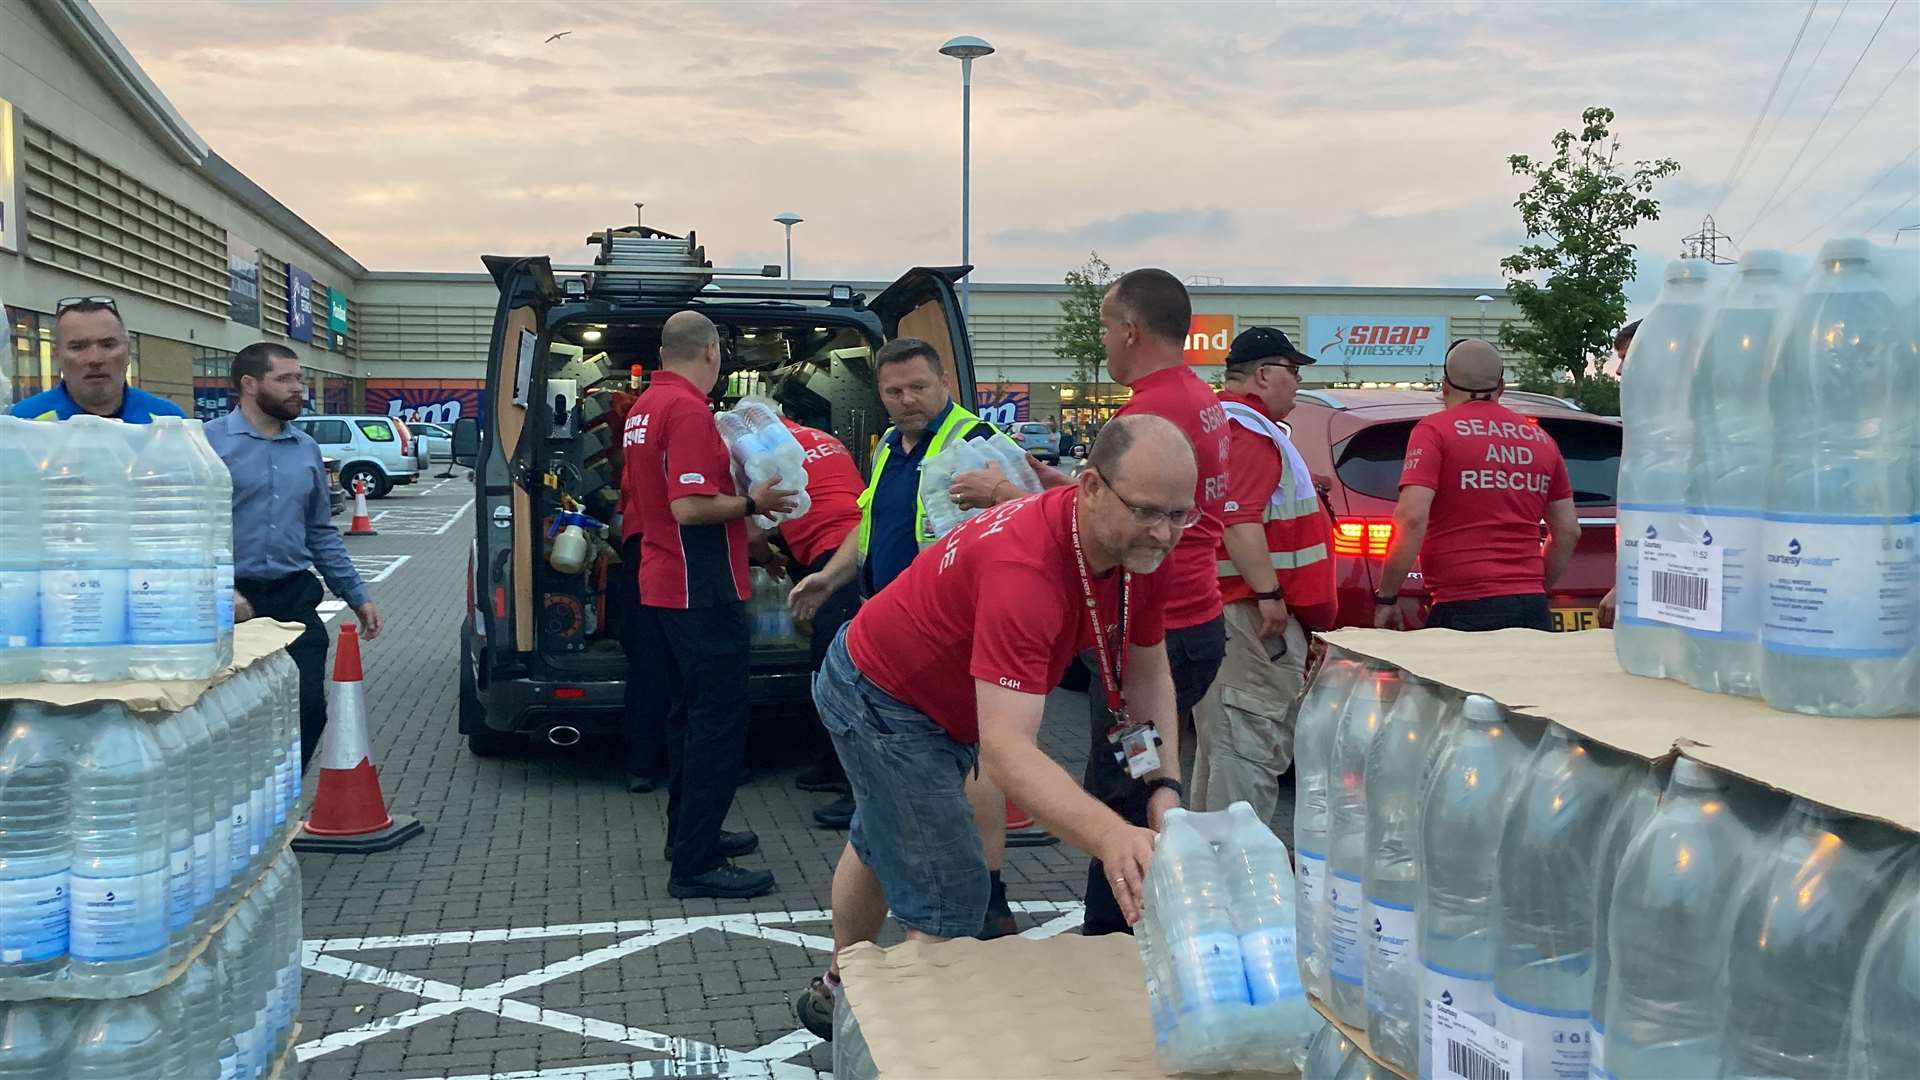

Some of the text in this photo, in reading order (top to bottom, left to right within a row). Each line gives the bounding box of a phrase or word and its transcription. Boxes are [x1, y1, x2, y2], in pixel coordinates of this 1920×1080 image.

[1454, 419, 1549, 444] SEARCH
[1485, 443, 1533, 465] AND
[1460, 469, 1551, 493] RESCUE
[1000, 676, 1020, 689] G4H
